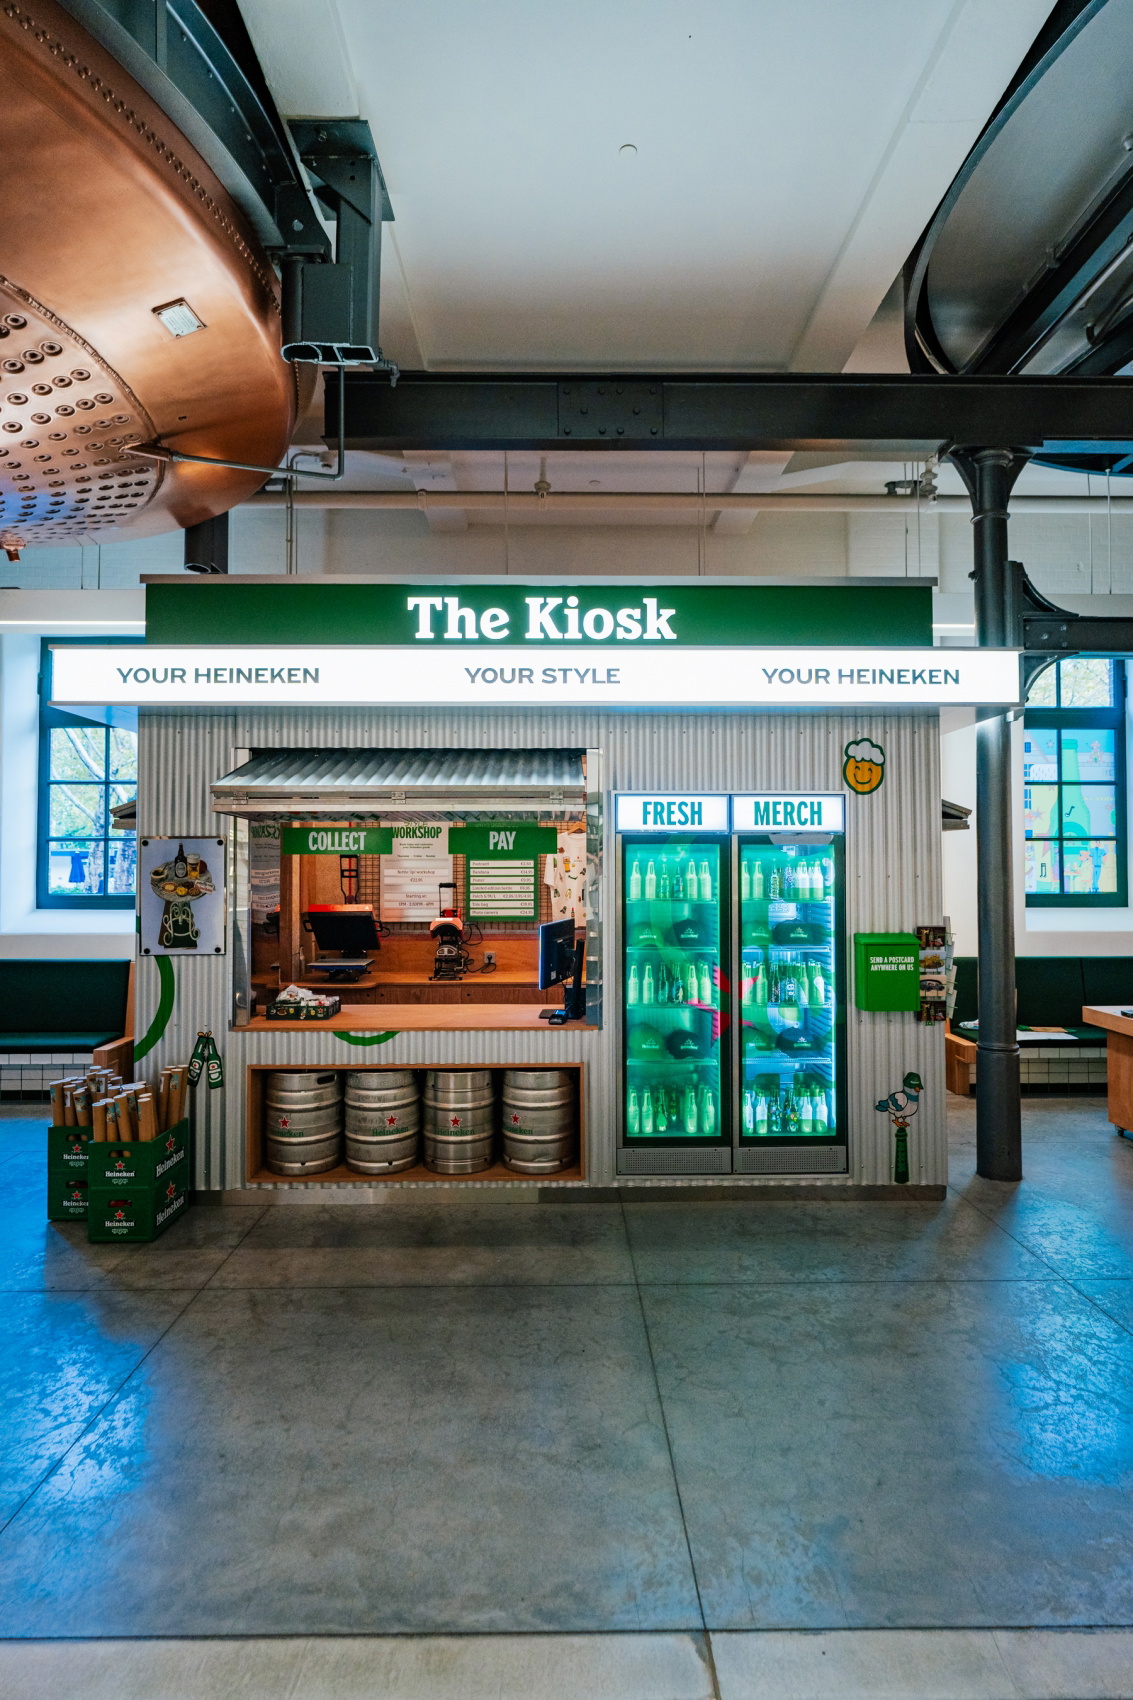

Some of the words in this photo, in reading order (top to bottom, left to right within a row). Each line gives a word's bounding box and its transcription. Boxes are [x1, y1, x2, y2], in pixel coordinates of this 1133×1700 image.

[406, 597, 510, 640] The
[524, 597, 677, 640] Kiosk
[117, 668, 187, 684] YOUR
[194, 668, 320, 684] HEINEKEN
[464, 668, 534, 684] YOUR
[541, 668, 620, 684] STYLE
[762, 668, 830, 684] YOUR
[838, 668, 960, 685] HEINEKEN
[642, 801, 702, 826] FRESH
[754, 801, 823, 826] MERCH
[308, 831, 366, 851] COLLECT
[392, 826, 442, 839] WORKSHOP
[489, 831, 517, 850] PAY
[371, 1126, 409, 1137] Heineken
[156, 1149, 185, 1178] Heineken
[156, 1195, 185, 1227] Heineken
